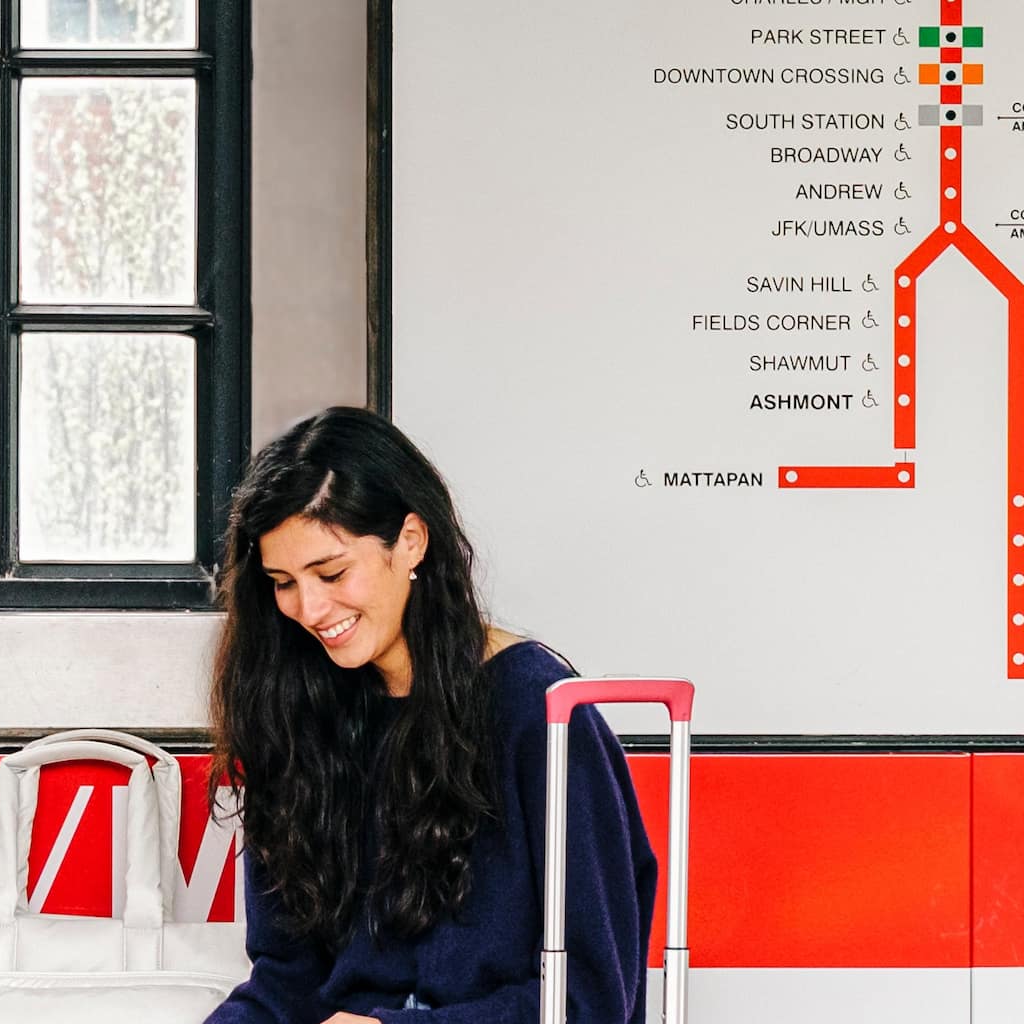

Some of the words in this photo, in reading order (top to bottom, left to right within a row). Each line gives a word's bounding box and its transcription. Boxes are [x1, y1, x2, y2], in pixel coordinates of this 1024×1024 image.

[751, 29, 804, 45] PARK
[809, 28, 887, 45] STREET
[653, 67, 774, 84] DOWNTOWN
[780, 67, 884, 85] CROSSING
[725, 113, 795, 130] SOUTH
[801, 113, 885, 130] STATION
[770, 146, 883, 164] BROADWAY
[795, 183, 884, 200] ANDREW
[771, 219, 885, 238] JFK/UMASS
[746, 276, 804, 293] SAVIN
[810, 276, 853, 293] HILL
[692, 314, 761, 332] FIELDS
[766, 314, 851, 331] CORNER
[749, 354, 852, 372] SHAWMUT
[749, 393, 854, 411] ASHMONT
[663, 472, 763, 487] MATTAPAN
